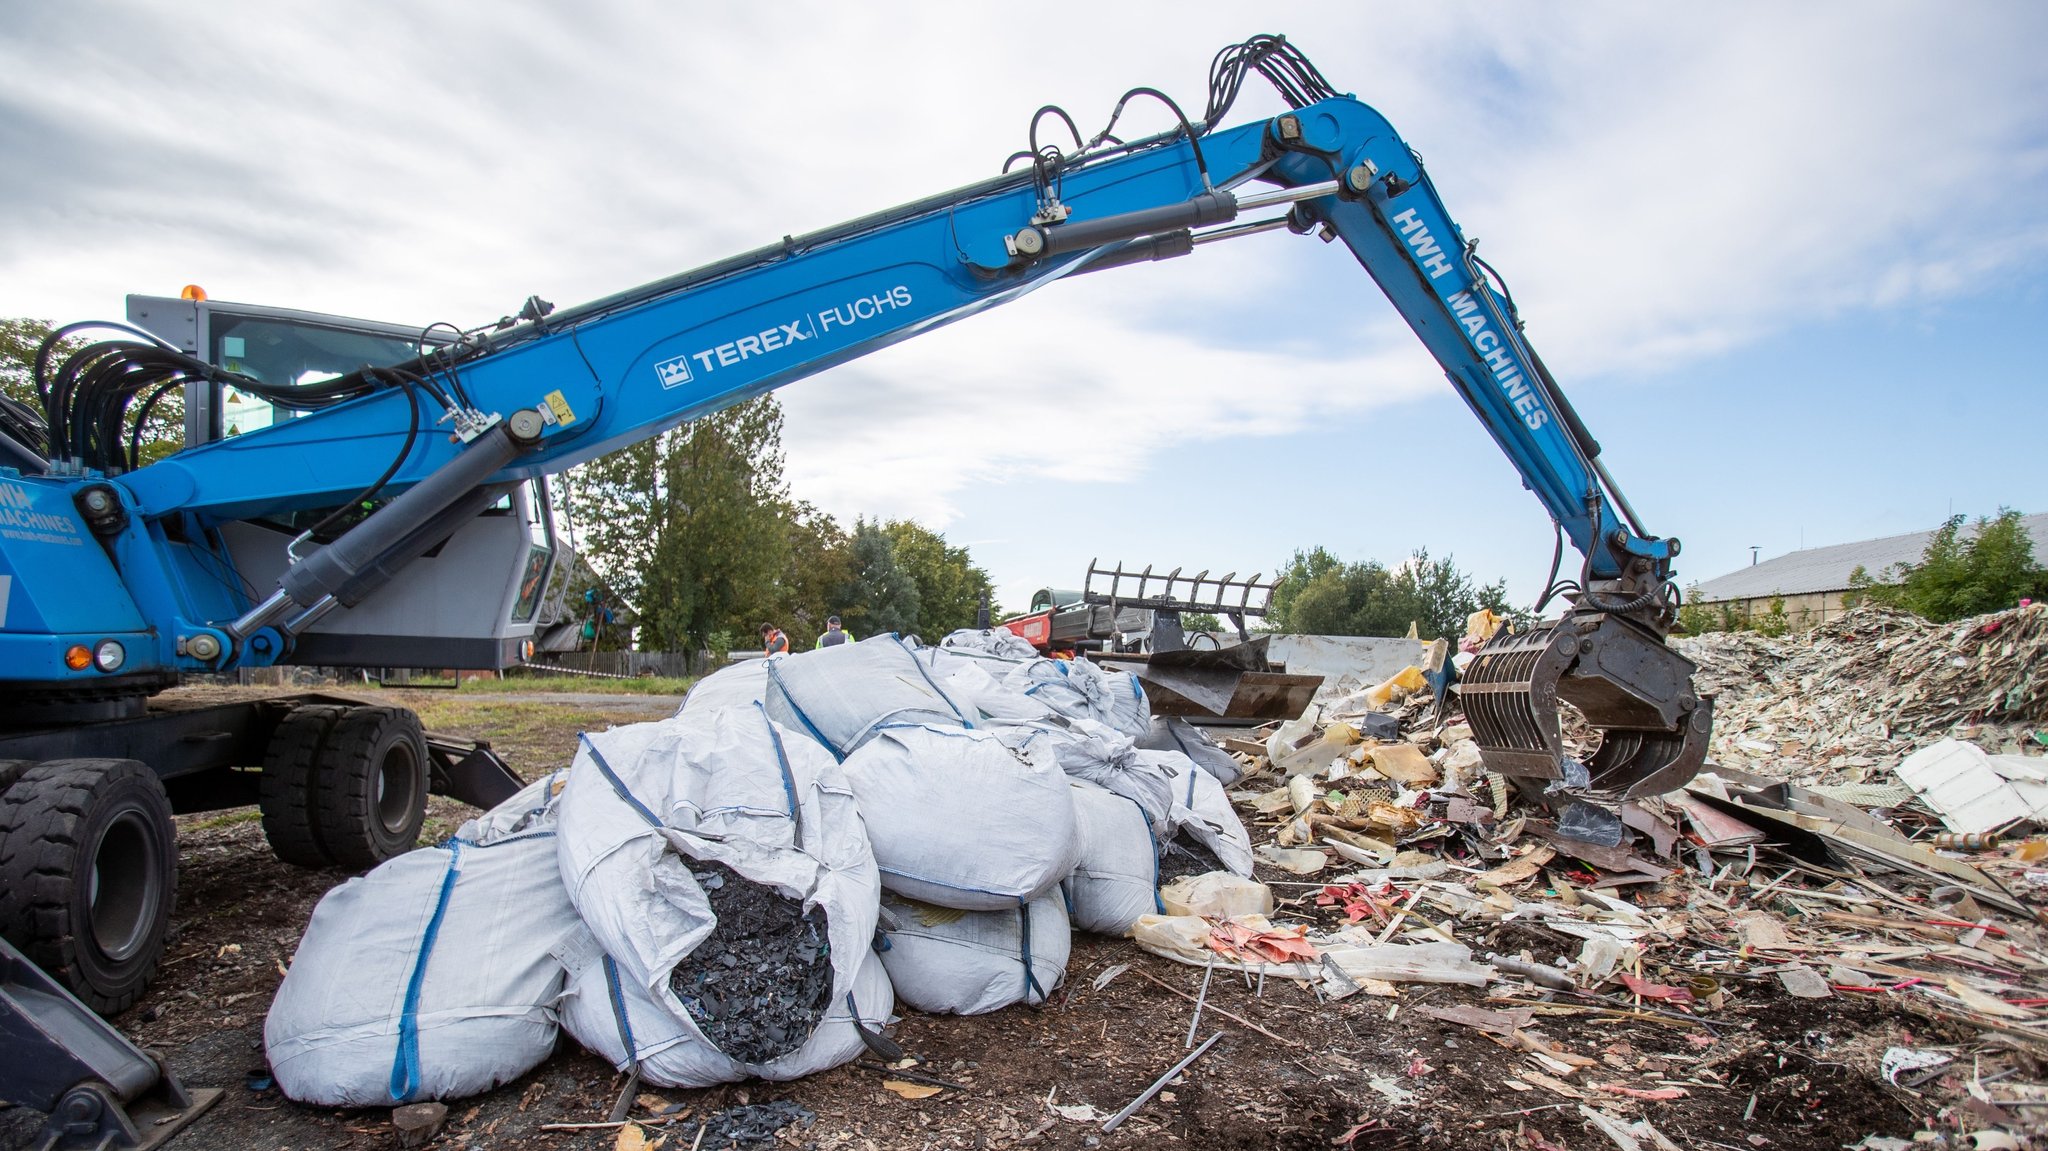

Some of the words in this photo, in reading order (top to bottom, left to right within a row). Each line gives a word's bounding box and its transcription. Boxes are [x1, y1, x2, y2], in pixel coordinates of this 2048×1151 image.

[693, 320, 807, 372] TEREX
[818, 285, 912, 332] FUCHS
[1393, 207, 1453, 279] HWH
[1447, 290, 1548, 431] MACHINES
